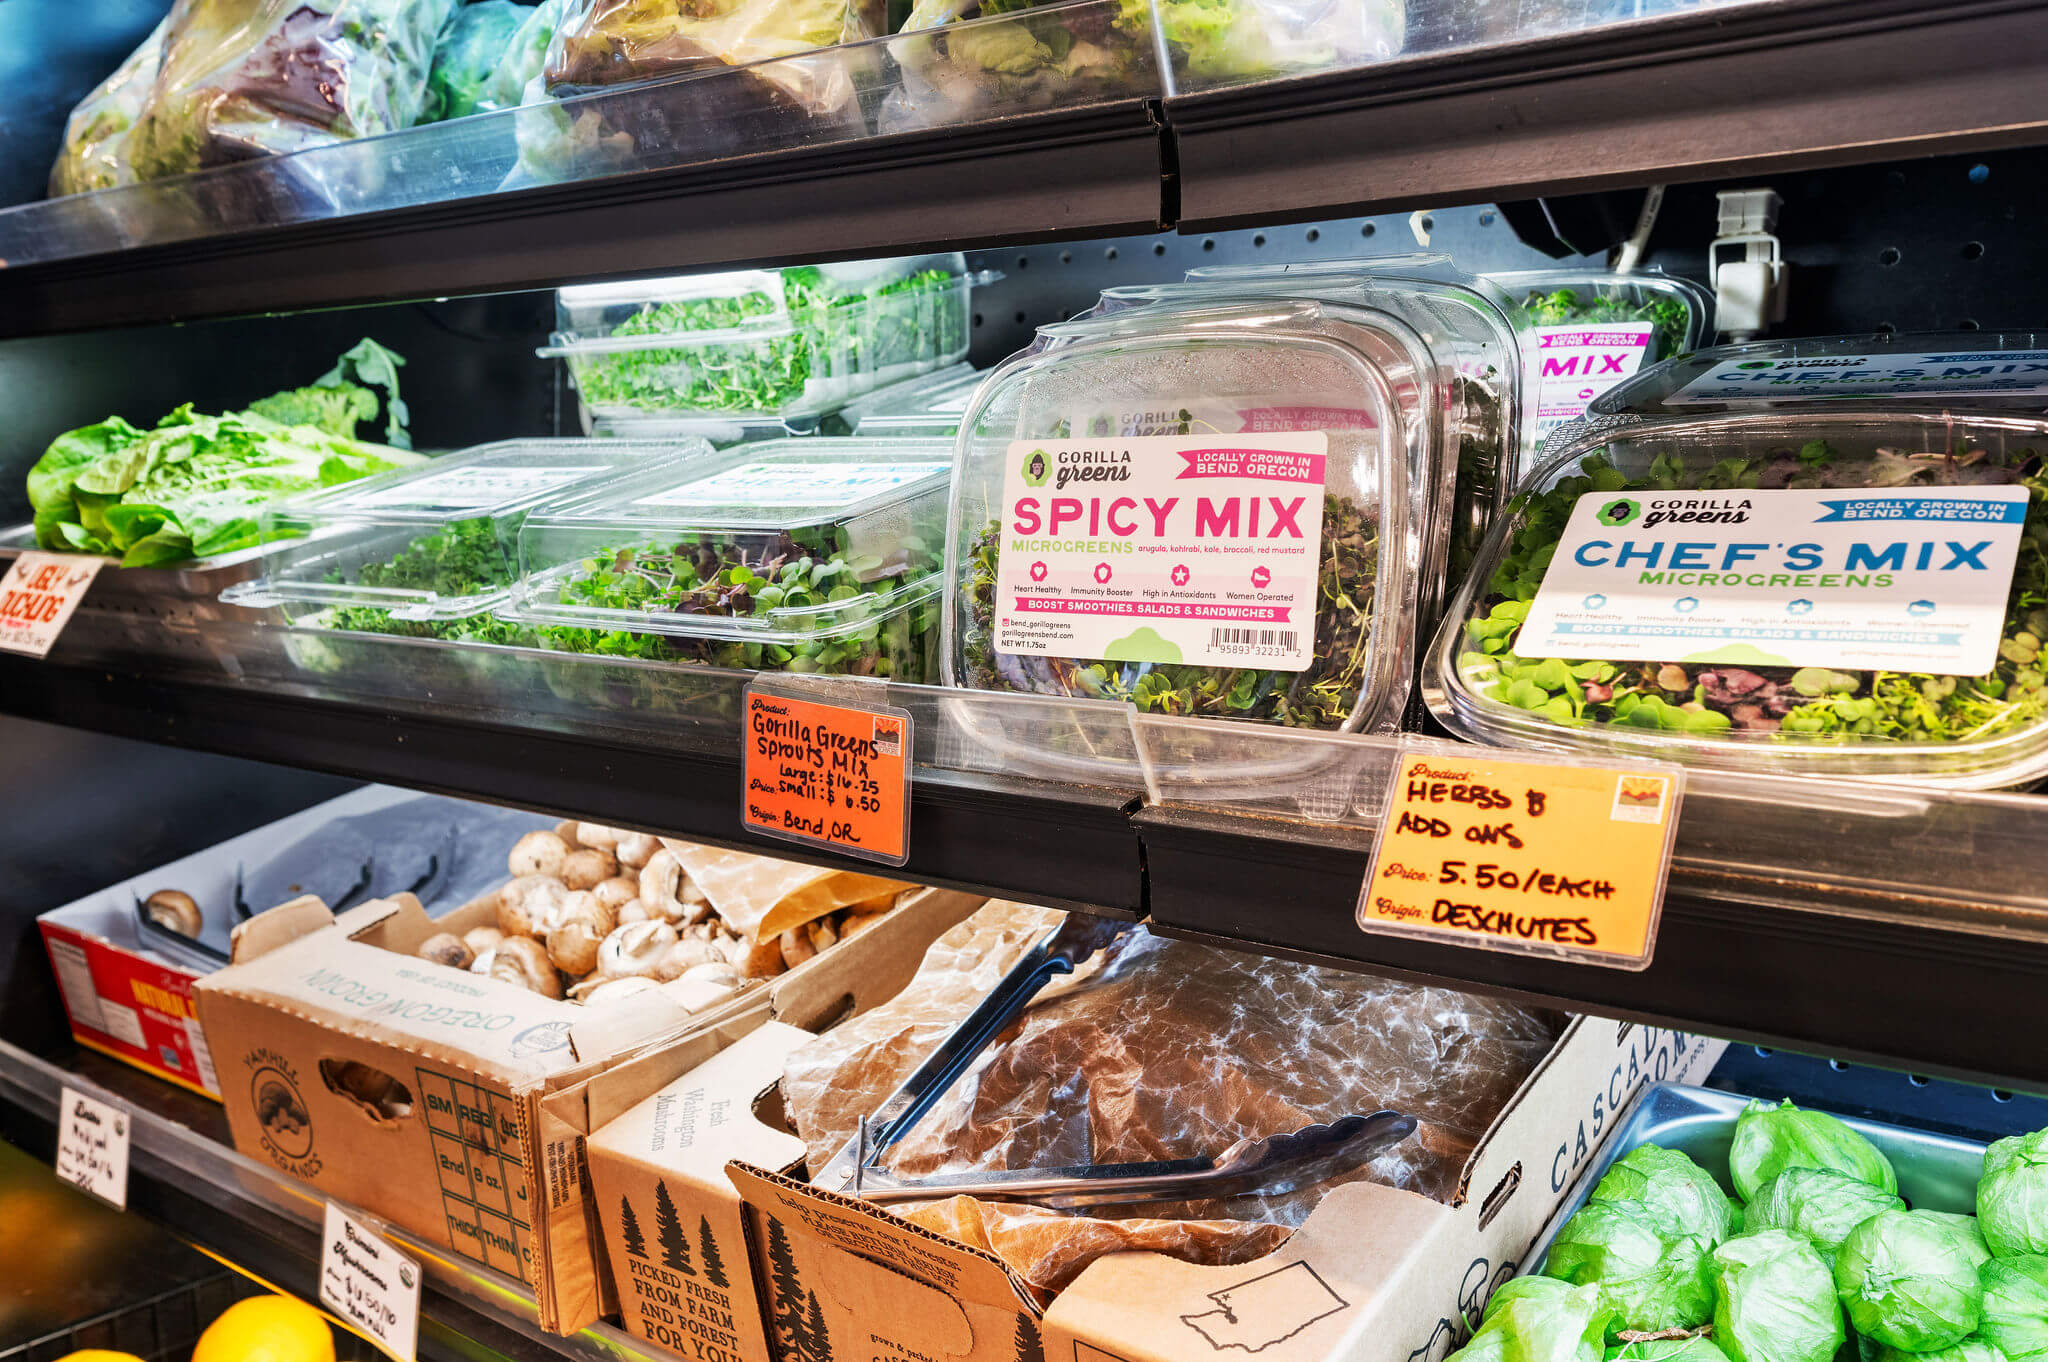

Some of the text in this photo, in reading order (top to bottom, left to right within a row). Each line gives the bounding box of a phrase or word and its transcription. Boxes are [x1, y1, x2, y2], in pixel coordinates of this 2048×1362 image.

[1542, 353, 1629, 377] MIX
[1717, 369, 1925, 381] CHEF'S
[1058, 450, 1132, 464] GORILLA
[1197, 453, 1311, 467] LOCALLY GROWN IN
[1056, 464, 1131, 490] greens
[1246, 463, 1310, 479] OREGON
[1650, 499, 1753, 510] GORILLA
[1845, 501, 2008, 511] LOCALLY GROWN IN
[1013, 497, 1307, 539] SPICY MIX
[1642, 510, 1750, 529] greens
[1914, 509, 2006, 521] OREGON
[1011, 539, 1133, 554] MICROGREENS
[1137, 544, 1305, 555] arugula, kohlrabi, kale, broccoli, red mustard
[1574, 540, 1995, 571] CHEF'S MIX
[1638, 571, 1894, 587] MICROGREENS
[1014, 584, 1062, 595] Heart Healthy
[1070, 587, 1134, 597] Immunity Booster
[1142, 589, 1217, 600] High in Antioxidants
[1226, 591, 1294, 602] Women Operated
[1028, 599, 1066, 609] BOOST
[1137, 604, 1181, 615] SALADS
[1183, 606, 1193, 616] &
[1194, 606, 1275, 619] SANDWICHES
[1010, 619, 1071, 630] bend_gorillagreens
[1571, 624, 1624, 634] BOOST
[1729, 627, 1795, 639] SALADS
[1817, 630, 1940, 643] SANDWICHES
[1001, 630, 1074, 640] gorillagreensbend.com
[1001, 639, 1047, 649] NET WT 1.75oz
[1205, 643, 1302, 658] 1 95893 32231 2
[752, 699, 790, 716] Product:
[753, 713, 879, 761] Gorilla Greens
[757, 737, 824, 768] Sprouts
[1408, 763, 1475, 782] Product:
[750, 778, 778, 795] Price:
[1407, 780, 1512, 810] HERBS
[749, 804, 780, 823] Origin:
[1395, 811, 1451, 838] ADD
[1383, 862, 1433, 882] Price:
[1376, 896, 1599, 947] Origin: DESCHUTES
[304, 968, 516, 1031] OREGON GROWN
[243, 1047, 299, 1086] YAMHILL
[426, 1094, 453, 1116] SM
[458, 1104, 492, 1129] REG
[674, 1087, 705, 1149] Washington
[710, 1098, 731, 1128] Fresh
[651, 1093, 677, 1152] Mushrooms
[260, 1135, 323, 1180] ORGANICS
[439, 1153, 465, 1176] 2nd
[447, 1215, 481, 1241] THICK
[482, 1230, 516, 1257] THIN
[628, 1258, 732, 1311] PICKED FRESH
[632, 1277, 736, 1332] FROM FARM
[640, 1300, 738, 1352] AND FOREST
[642, 1318, 688, 1355] FOR
